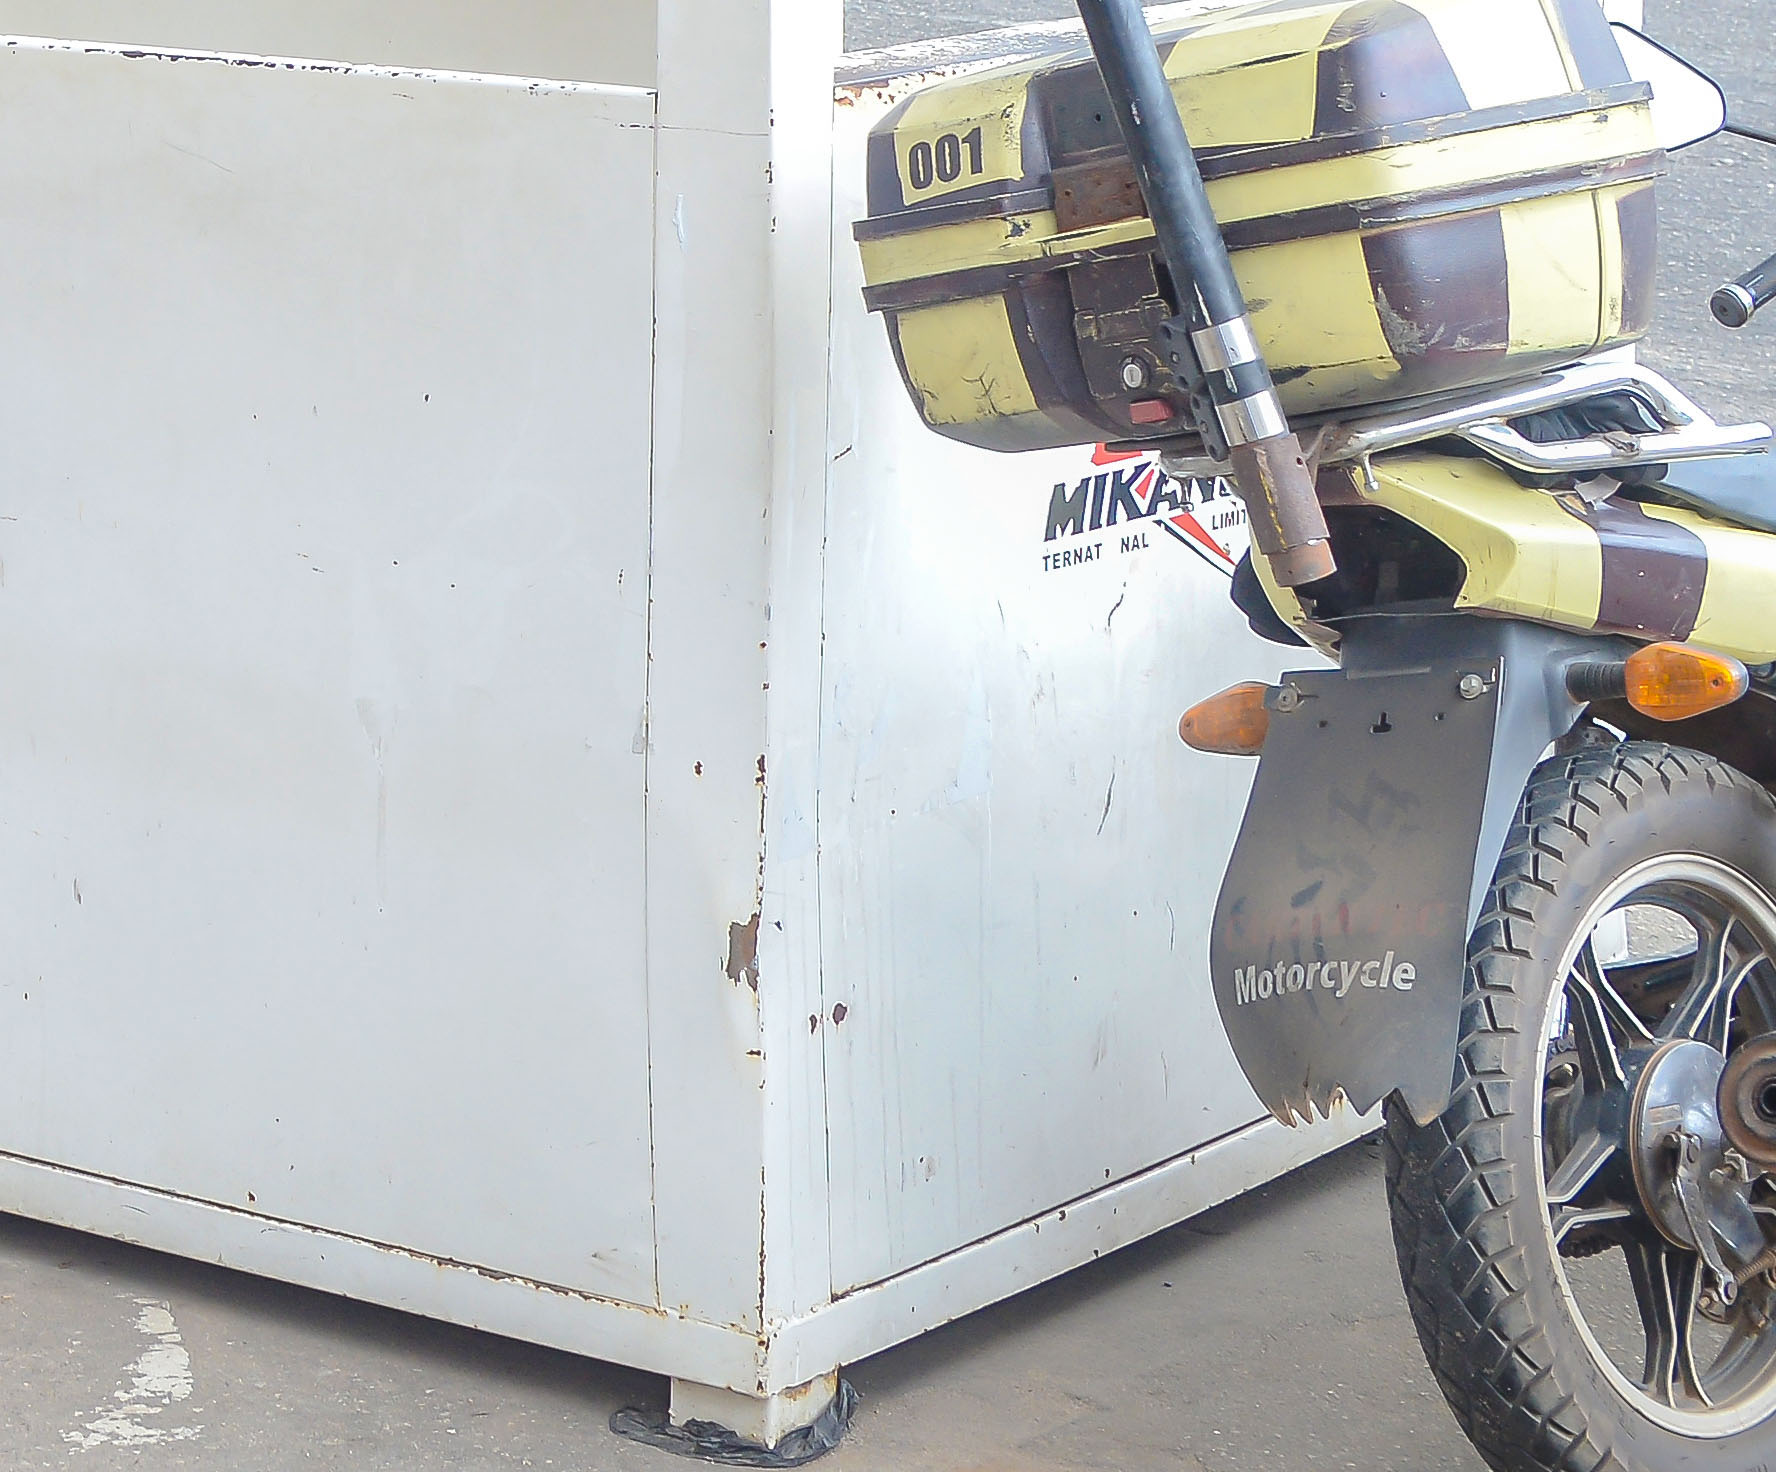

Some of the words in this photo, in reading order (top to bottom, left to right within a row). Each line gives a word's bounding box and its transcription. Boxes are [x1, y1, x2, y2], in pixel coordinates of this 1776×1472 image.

[908, 125, 984, 190] 001
[1043, 460, 1233, 542] MIKAN
[1211, 509, 1246, 530] LIMIT
[1234, 950, 1417, 1006] Motorcycle
